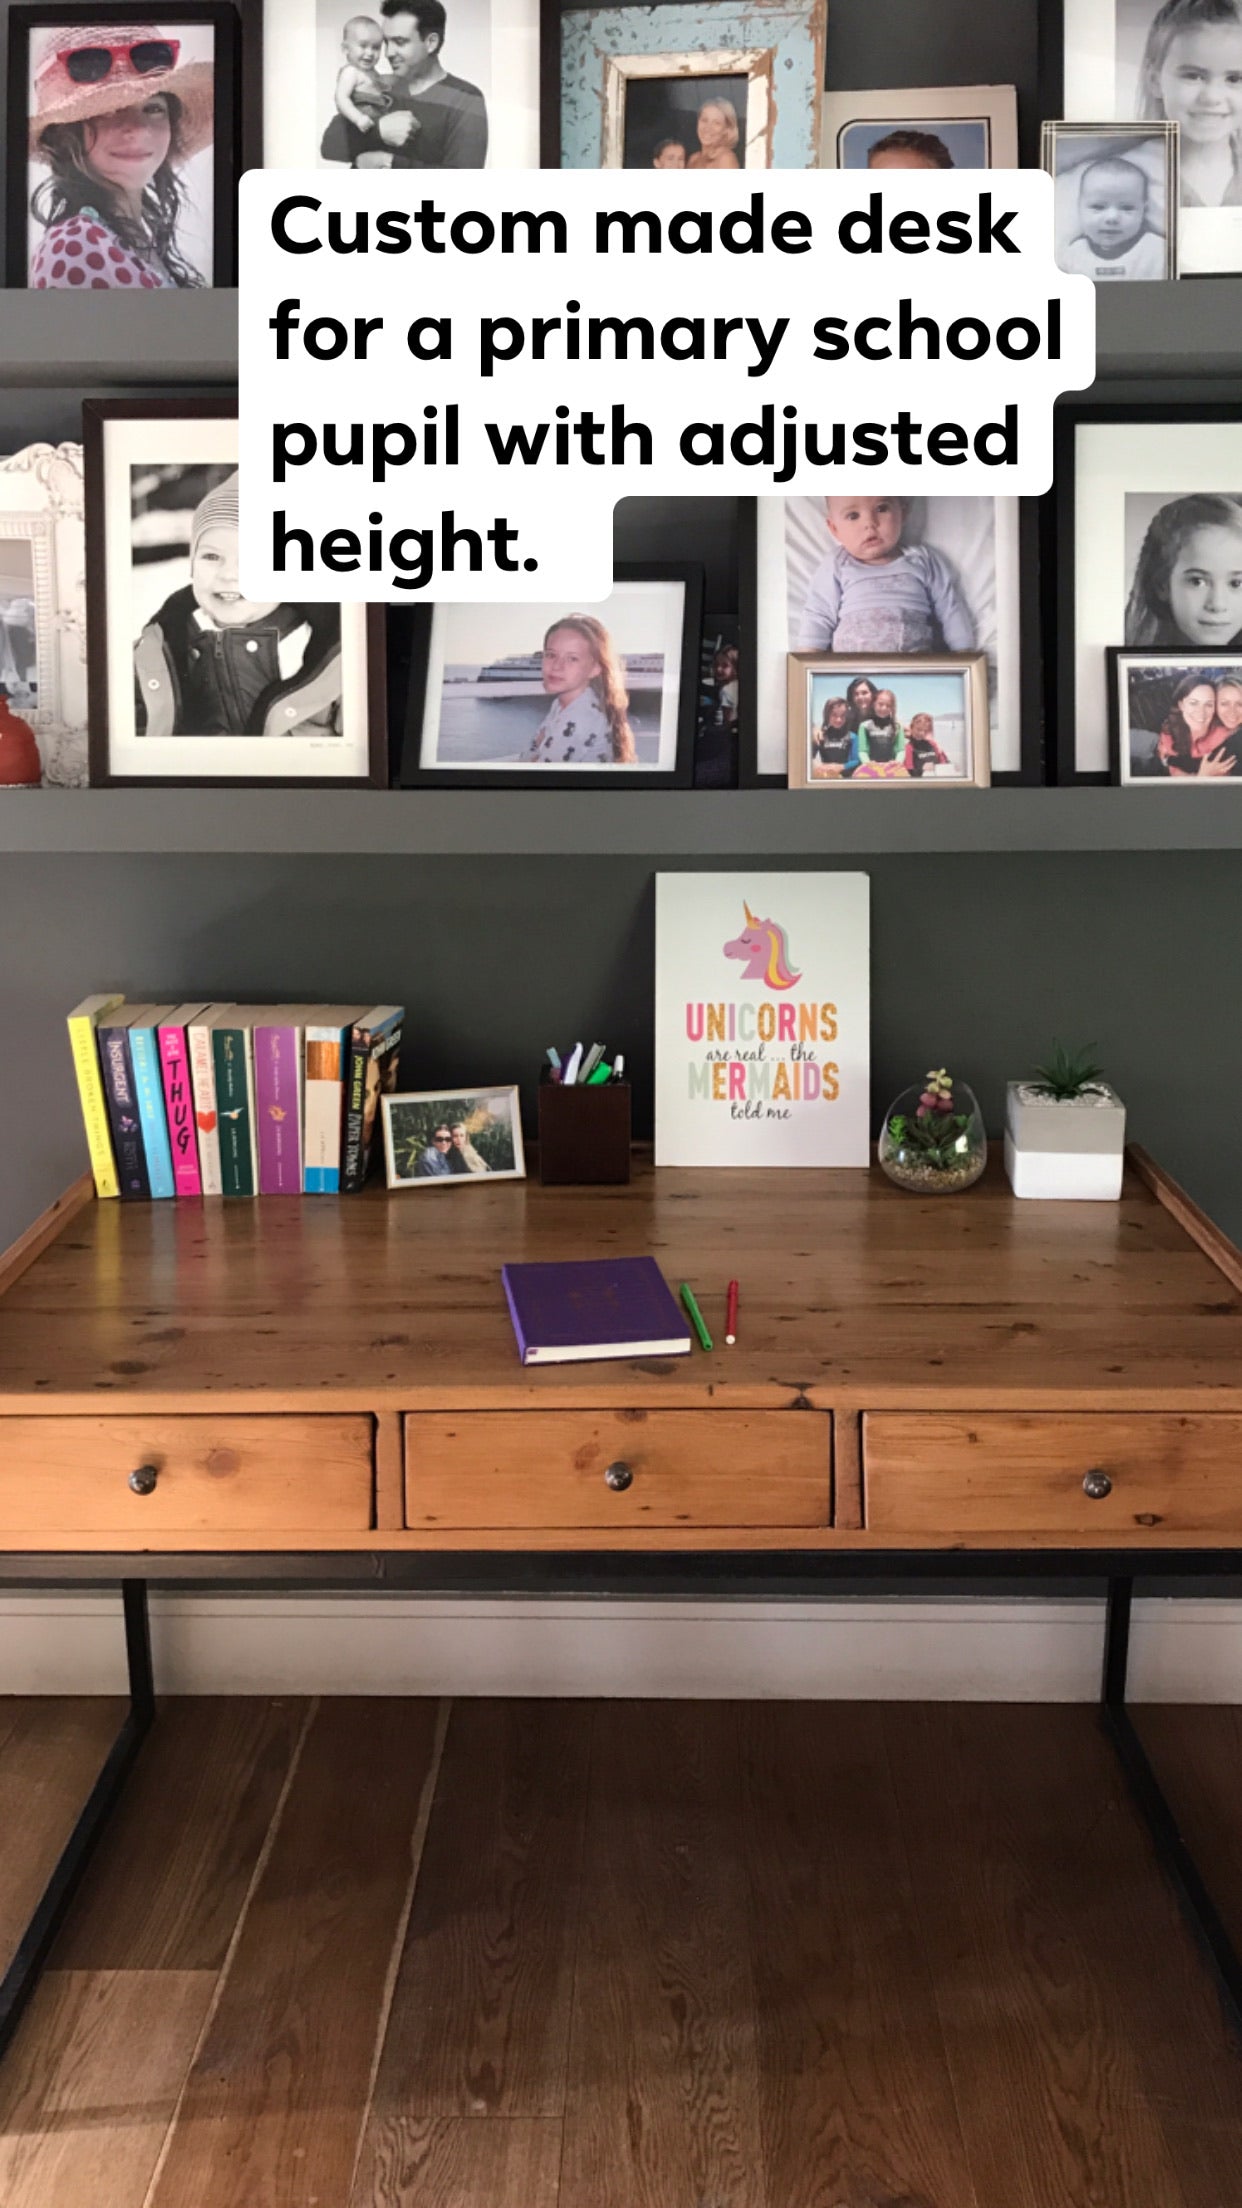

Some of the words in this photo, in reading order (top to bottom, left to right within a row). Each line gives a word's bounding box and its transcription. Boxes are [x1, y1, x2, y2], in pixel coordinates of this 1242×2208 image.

[686, 1003, 838, 1042] UNICORNS
[353, 1055, 364, 1078] JOHN
[706, 1049, 732, 1061] are
[733, 1042, 766, 1062] real
[790, 1042, 817, 1062] the
[108, 1040, 130, 1104] INSURGENT
[688, 1062, 840, 1101] MERMAIDS
[351, 1080, 363, 1110] GREEN
[731, 1100, 764, 1120] told
[766, 1107, 792, 1120] me
[83, 1068, 98, 1112] BROKEN
[91, 1116, 105, 1156] THINGS
[346, 1112, 362, 1142] PAPER
[345, 1144, 359, 1176] TOWNS
